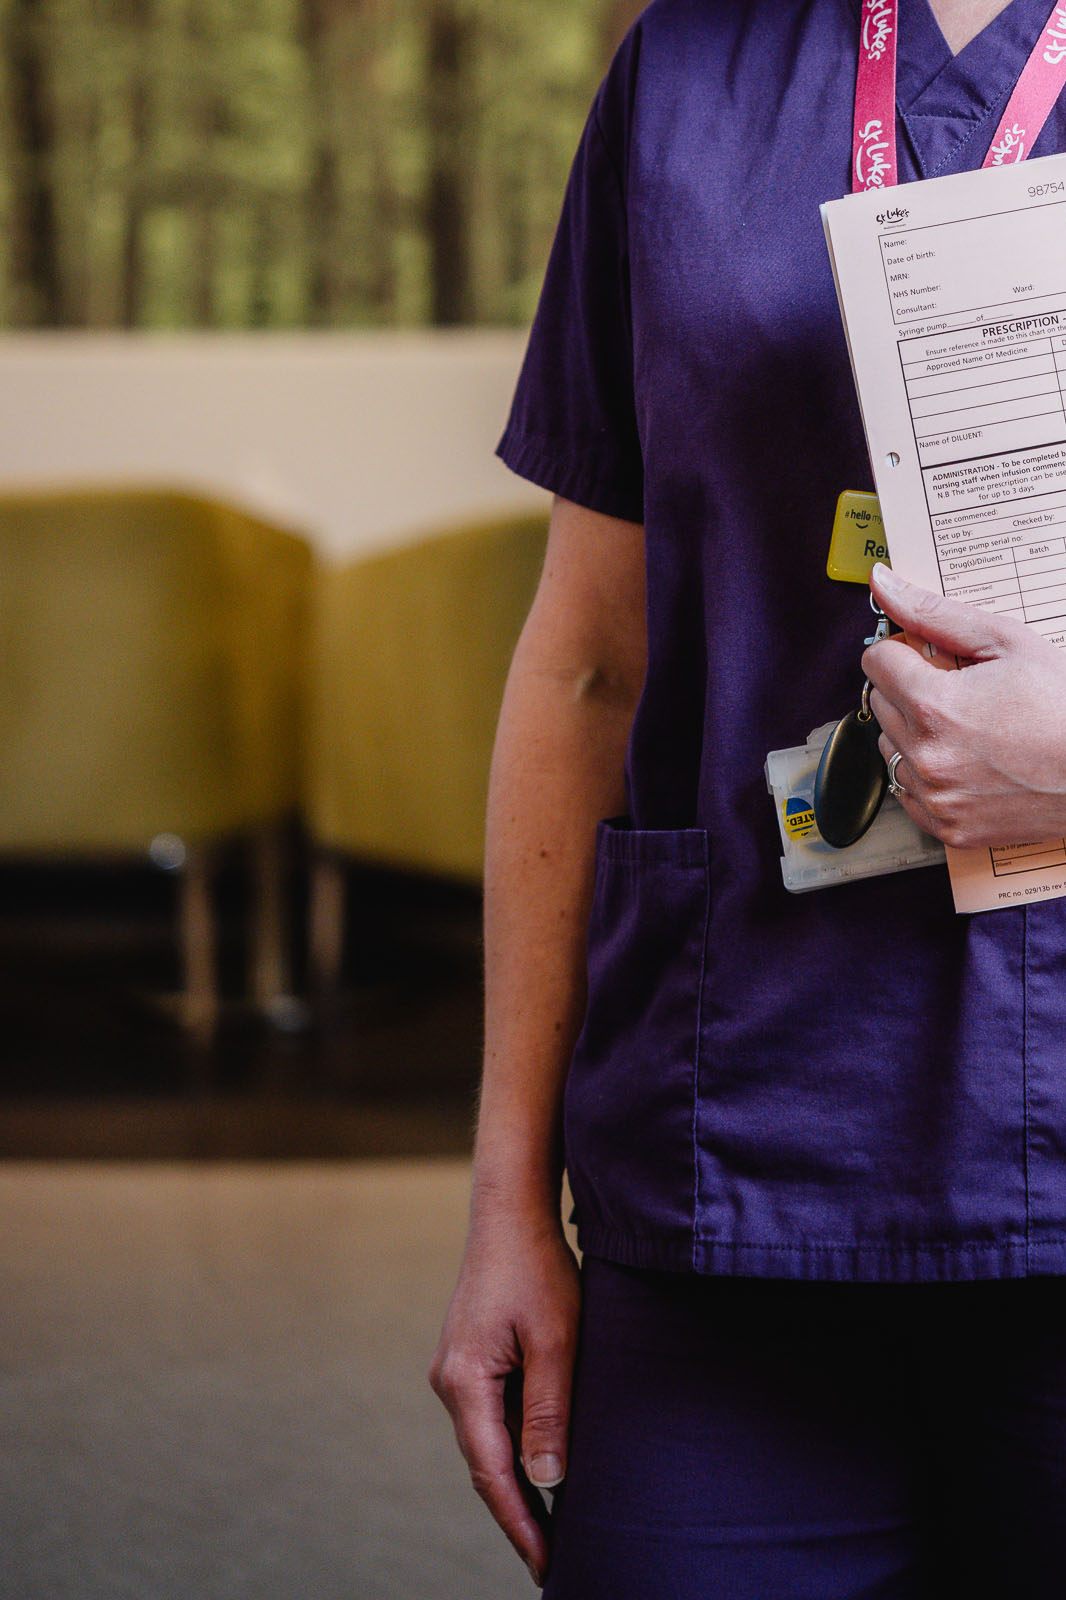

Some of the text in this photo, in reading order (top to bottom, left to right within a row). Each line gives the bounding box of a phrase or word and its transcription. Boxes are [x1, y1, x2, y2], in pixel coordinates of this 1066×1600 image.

[992, 123, 1025, 165] uke's
[1027, 181, 1064, 197] 98754
[883, 239, 907, 248] Name:
[886, 250, 936, 265] Date of birth:
[889, 272, 910, 282] MRN:
[893, 284, 941, 298] NHS Number:
[895, 303, 936, 315] Consultant:
[898, 326, 924, 337] Syringe
[982, 314, 1059, 337] PRESCRIPTION
[926, 347, 1027, 371] Approved Name Of Medicine
[918, 440, 939, 448] Name
[941, 436, 949, 444] of
[932, 464, 994, 481] ADMINISTRATION
[1022, 451, 1059, 464] completed
[932, 481, 959, 490] nursing
[961, 475, 977, 485] staff
[979, 473, 1000, 481] when
[1001, 467, 1030, 477] infusion
[966, 485, 984, 493] same
[986, 477, 1028, 491] prescription
[1018, 485, 1034, 493] days
[934, 518, 952, 526] Date
[1012, 513, 1055, 526] Checked by:
[937, 533, 949, 541] Set
[961, 529, 973, 537] by:
[940, 546, 966, 556] Syringe
[968, 542, 989, 552] pump
[990, 536, 1009, 546] serial
[1029, 545, 1049, 554] Batch
[949, 554, 1003, 569] Drug(s)/Diluent
[998, 891, 1011, 899] PRC
[1024, 885, 1050, 895] 029/13b
